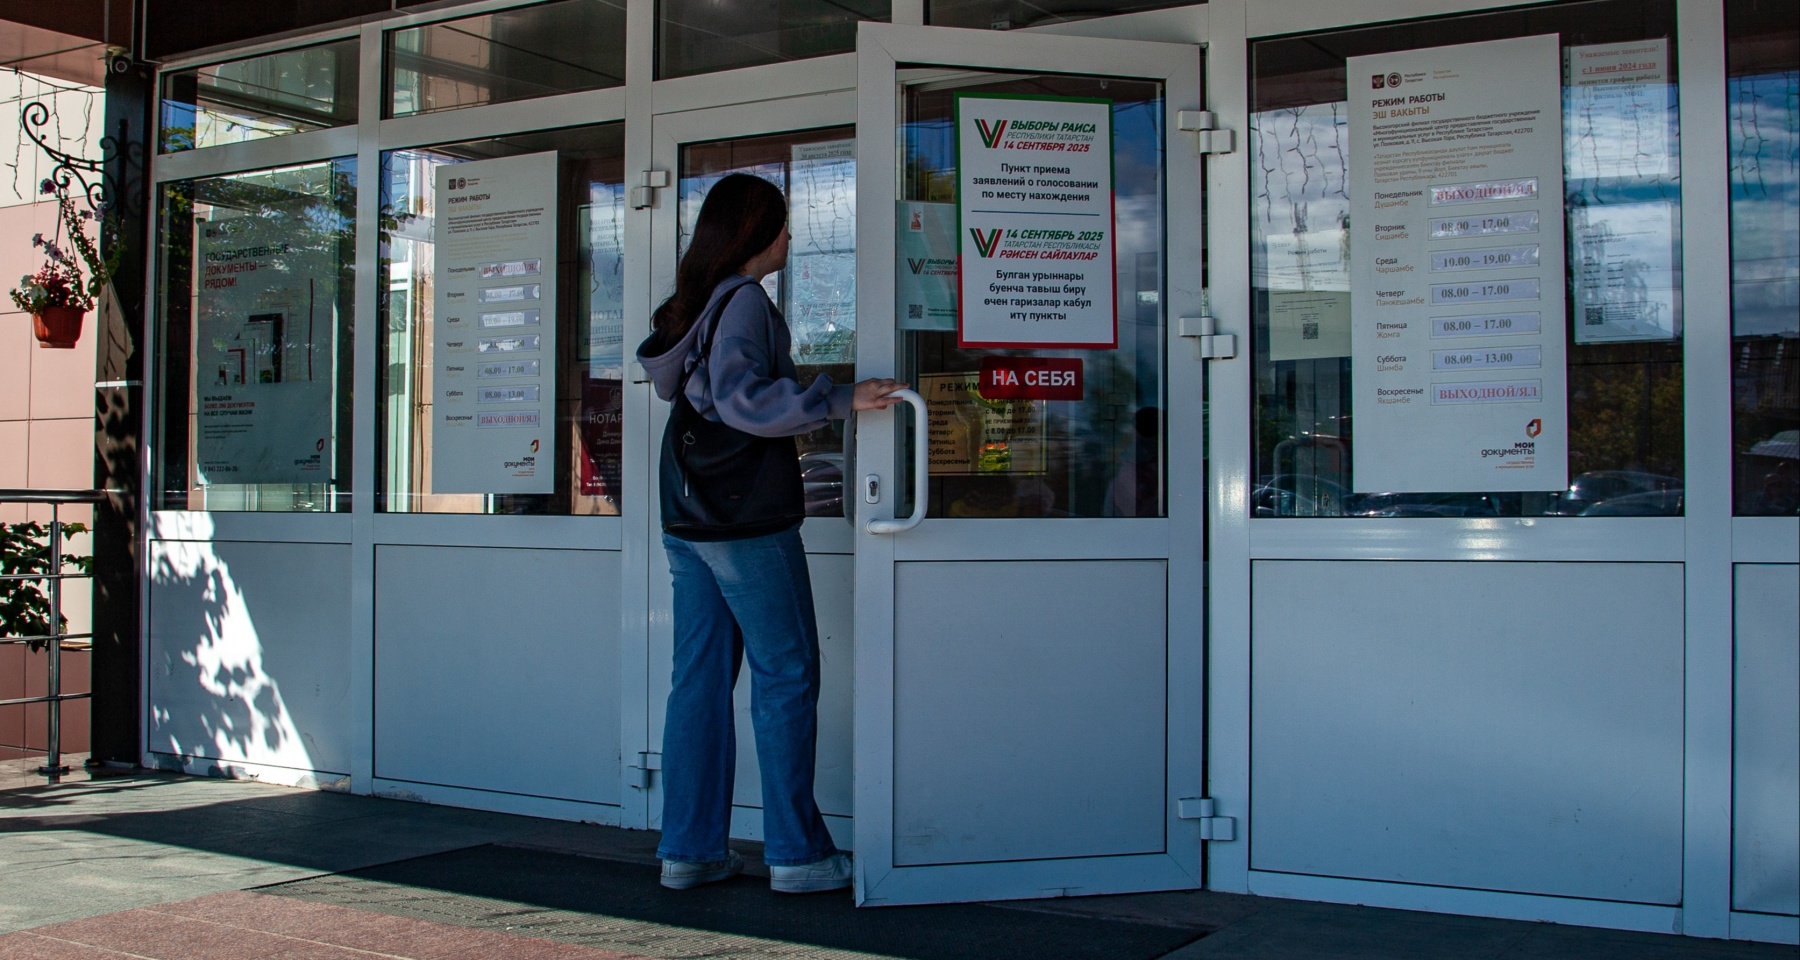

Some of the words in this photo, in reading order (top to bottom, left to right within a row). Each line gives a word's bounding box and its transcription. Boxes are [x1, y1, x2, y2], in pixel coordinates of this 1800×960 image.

[1580, 50, 1619, 58] Уважаемые
[1619, 62, 1636, 70] 2024
[1610, 76, 1634, 84] график
[1372, 97, 1405, 107] РЕЖИМ
[1409, 93, 1445, 104] РАБОТЫ
[1391, 106, 1429, 118] ВАКЫТЫ
[1373, 122, 1410, 130] Высокогорский
[1431, 116, 1475, 124] государственного
[1476, 112, 1507, 120] бюджетного
[1509, 109, 1540, 117] учреждения
[1451, 120, 1491, 129] предоставления
[1492, 116, 1536, 125] государственных
[1011, 120, 1059, 131] ВЫБОРЫ
[1061, 122, 1096, 133] РАИСА
[1007, 132, 1055, 140] РЕСПУБЛИКИ
[1057, 134, 1094, 142] ТАТАРСТАН
[1436, 128, 1465, 137] Республике
[1004, 141, 1014, 149] 14
[1017, 142, 1065, 151] СЕНТЯБРЯ
[1067, 144, 1090, 152] 2025
[1001, 163, 1030, 174] Пункт
[1034, 165, 1070, 175] приема
[973, 177, 1025, 186] заявлений
[1037, 179, 1098, 188] голосовании
[448, 196, 467, 204] РЕЖИМ
[470, 194, 490, 202] РАБОТЫ
[997, 191, 1026, 201] месту
[1029, 192, 1089, 202] нахождения
[1375, 190, 1423, 200] Понедельник
[1375, 224, 1405, 232] Вторник
[1442, 221, 1468, 231] 08.00
[1482, 218, 1509, 229] 17.00
[1006, 229, 1018, 238] 14
[1021, 230, 1074, 240] СЕНТЯБРЬ
[1077, 231, 1103, 241] 2025
[1043, 242, 1100, 250] РЕСПУБЛИКАСЫ
[206, 244, 290, 262] ГОСУДАРСТВЕННЫЕ
[999, 250, 1037, 259] РӘИСЕН
[1040, 249, 1098, 260] САЙЛАУЛАР
[1376, 258, 1397, 266] Среда
[1443, 257, 1470, 267] 10.00
[1484, 254, 1510, 264] 19.00
[205, 262, 257, 277] ДОКУМЕНТЫ
[997, 270, 1030, 280] Булган
[1033, 272, 1083, 282] урыннары
[205, 277, 237, 290] РЯДОМ!
[990, 283, 1023, 294] буенча
[1063, 284, 1086, 295] бирү
[1376, 289, 1404, 298] Четверг
[1442, 287, 1468, 298] 08.00
[1482, 285, 1509, 296] 17.00
[1011, 299, 1060, 308] гаризалар
[1064, 299, 1091, 309] кабул
[1010, 312, 1026, 321] итү
[1030, 312, 1066, 321] пункты
[1377, 322, 1407, 330] Пятница
[1444, 321, 1471, 331] 08.00
[1484, 319, 1511, 329] 17.00
[1377, 355, 1406, 364] Суббота
[1445, 354, 1472, 364] 08.00
[1485, 353, 1512, 363] 13.00
[993, 370, 1019, 385] НА
[1025, 371, 1075, 386] СЕБЯ
[940, 383, 979, 392] РЕЖИМ
[1378, 388, 1423, 396] Воскресенье
[1440, 386, 1537, 399] ВЫХОДНОЙ/ЯЛ
[1482, 449, 1534, 457] документы
